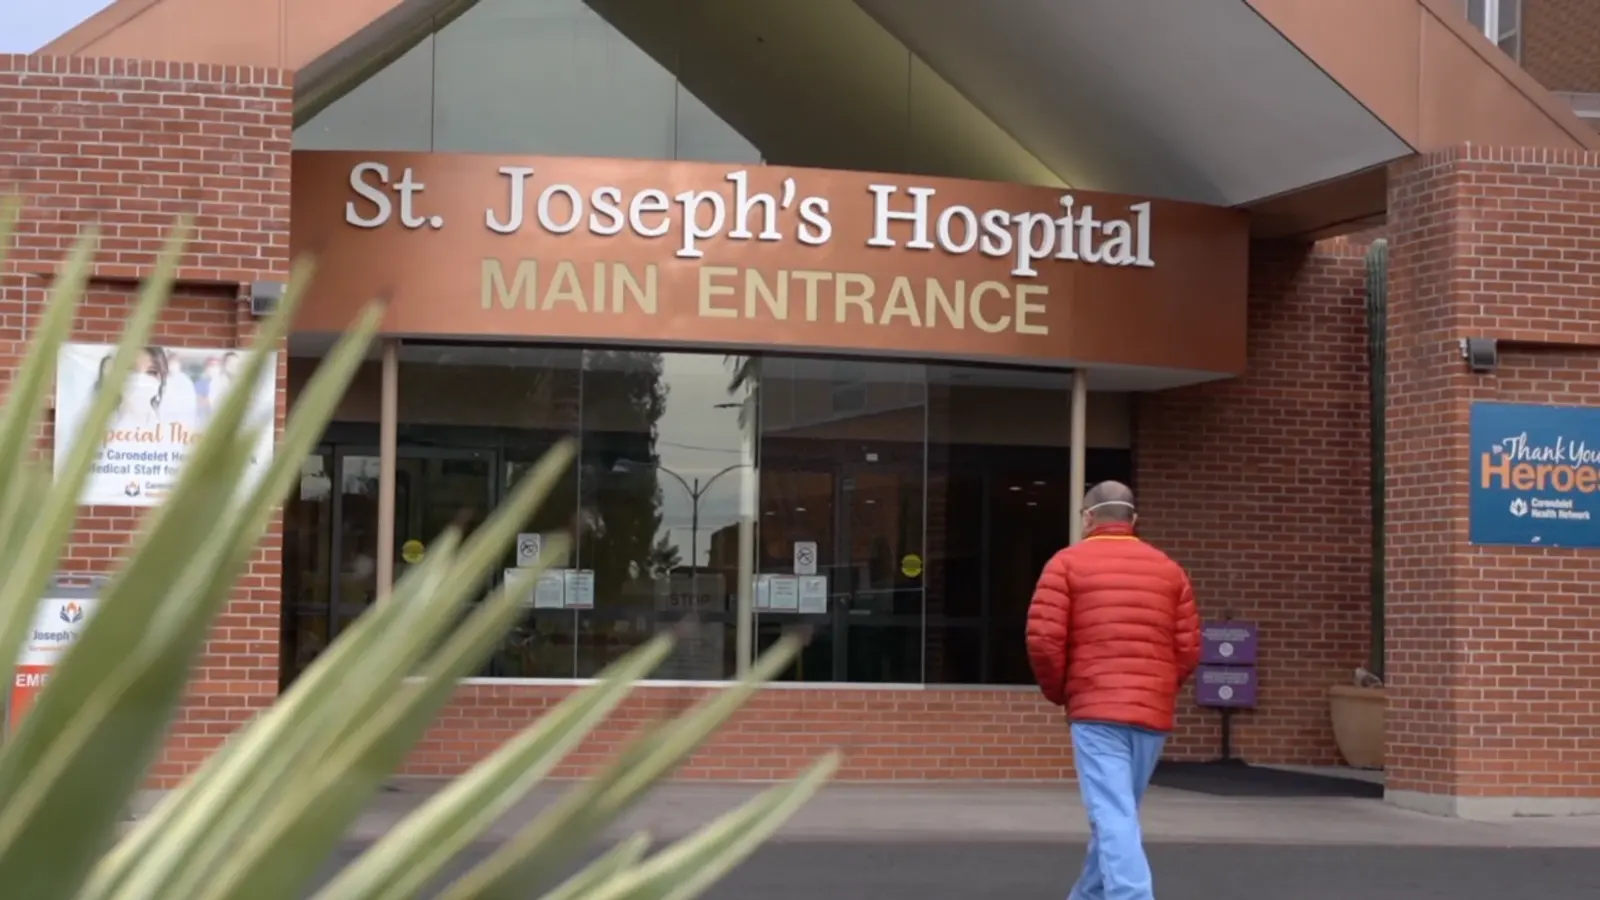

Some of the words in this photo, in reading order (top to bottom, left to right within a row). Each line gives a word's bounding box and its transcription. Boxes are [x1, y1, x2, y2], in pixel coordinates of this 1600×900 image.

[345, 161, 444, 230] St.
[484, 166, 833, 259] Joseph's
[867, 184, 1156, 278] Hospital
[481, 258, 659, 315] MAIN
[698, 266, 1051, 336] ENTRANCE
[101, 423, 164, 449] pecial
[1502, 431, 1566, 463] Thank
[107, 450, 169, 463] Carondelet
[134, 463, 162, 476] Staff
[1481, 451, 1600, 493] Heroe
